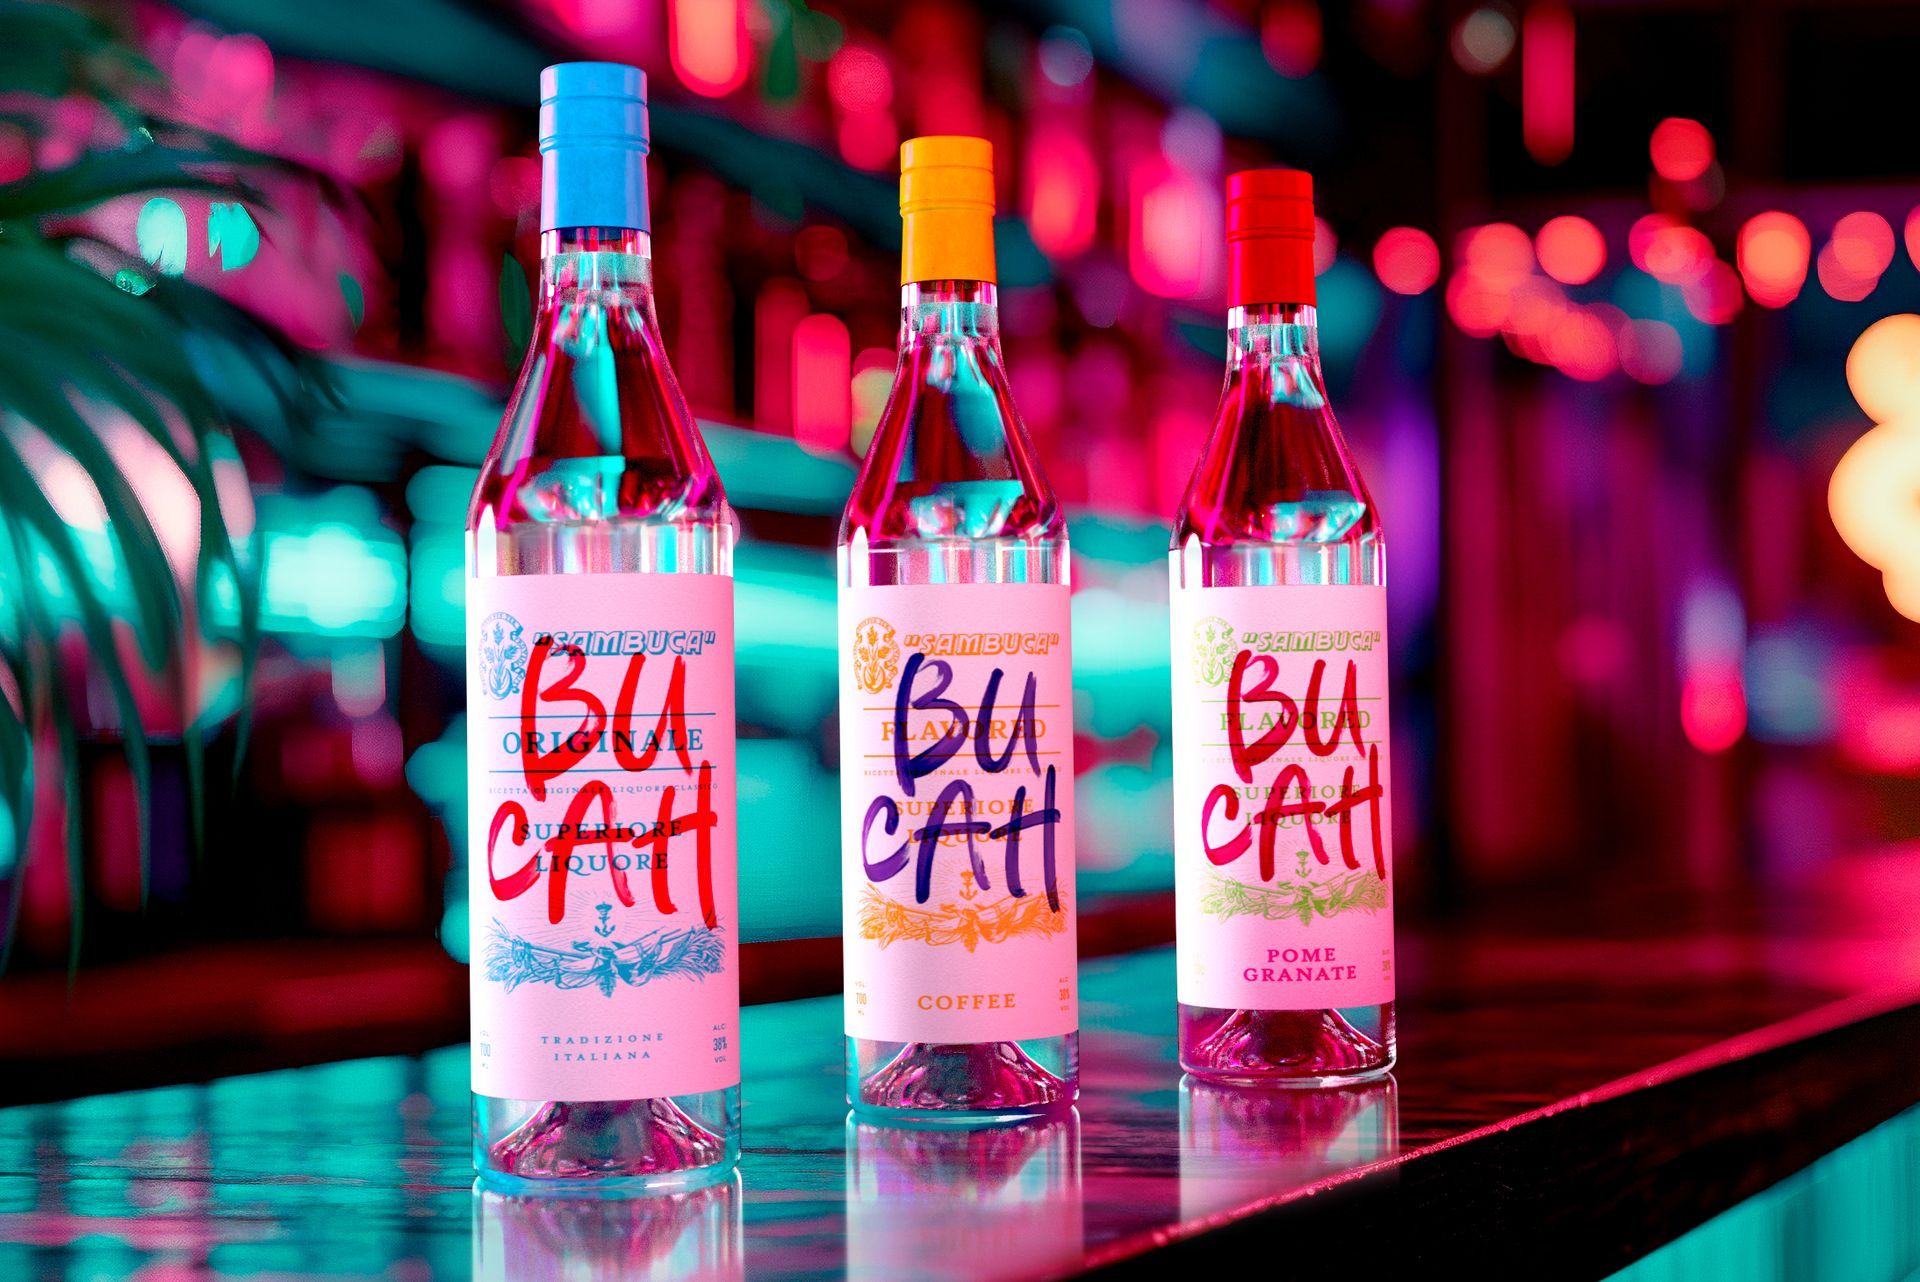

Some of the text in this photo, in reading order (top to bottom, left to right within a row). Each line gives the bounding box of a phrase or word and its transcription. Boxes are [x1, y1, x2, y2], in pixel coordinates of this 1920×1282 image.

[521, 635, 693, 802] BU
[894, 652, 1041, 797] BU
[1220, 710, 1371, 731] FLAVORED
[1227, 649, 1366, 784] BU
[502, 728, 704, 754] ORIGINALE
[881, 719, 1046, 742] FLAVORED
[1232, 784, 1361, 801] SUPERIORE
[895, 798, 1034, 817] SUPERIORE
[1201, 743, 1386, 882] CAH
[520, 820, 683, 841] SUPERIORE
[1245, 811, 1351, 830] LIQUORE
[487, 760, 718, 931] CAH
[862, 764, 1061, 913] CAH
[907, 827, 1023, 848] LIQUORE
[535, 853, 669, 876] LIQUORE
[1266, 947, 1336, 963] POME
[1243, 965, 1357, 982] GRANATE
[917, 993, 1017, 1011] COFFEE
[540, 1032, 664, 1045] TRADIZIONE
[553, 1050, 651, 1062] ITALIANA
